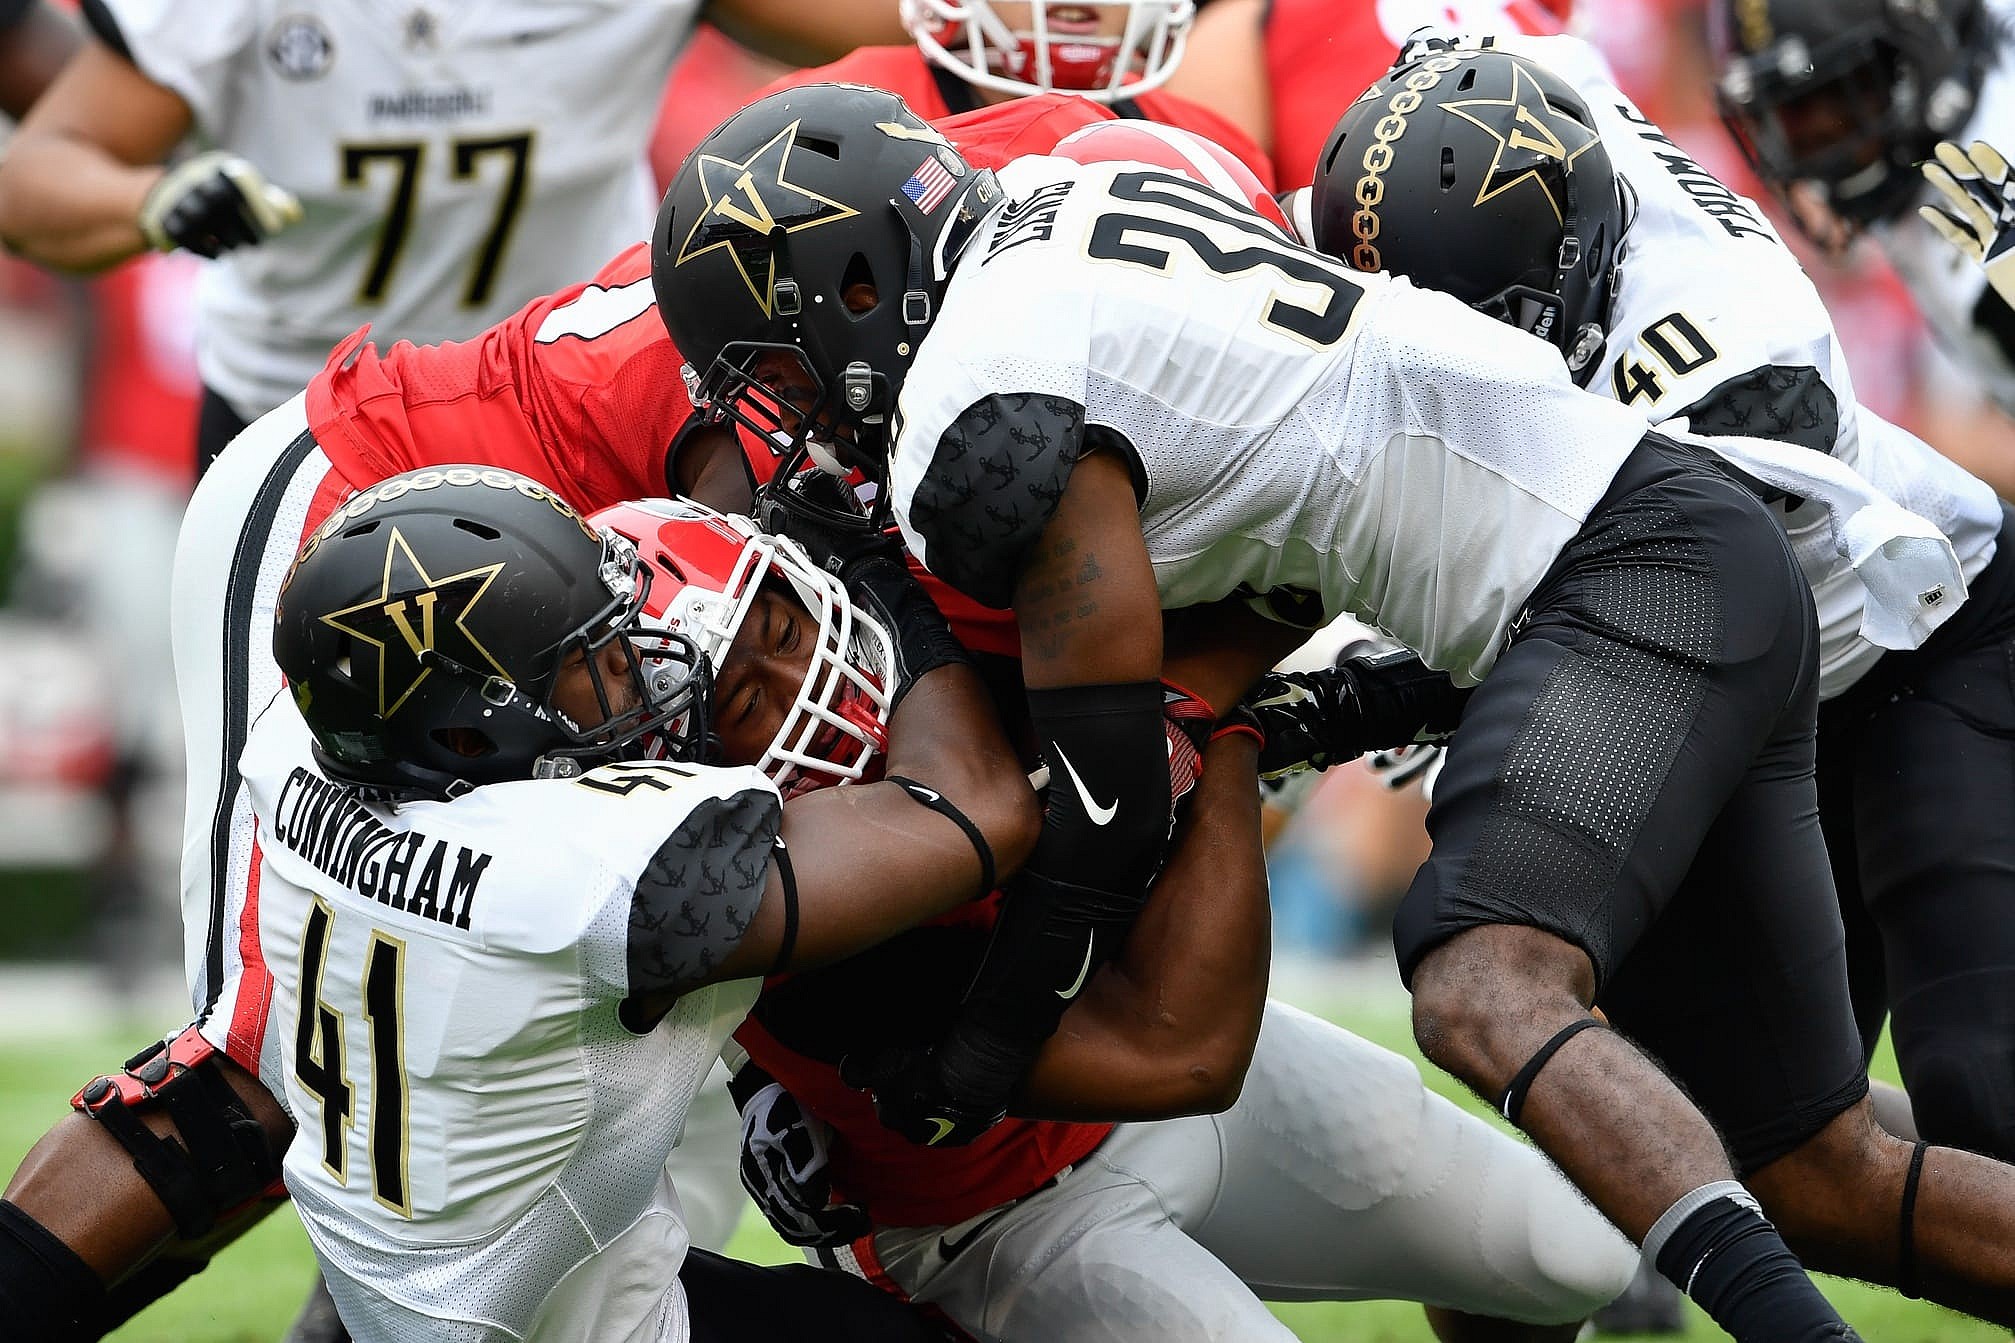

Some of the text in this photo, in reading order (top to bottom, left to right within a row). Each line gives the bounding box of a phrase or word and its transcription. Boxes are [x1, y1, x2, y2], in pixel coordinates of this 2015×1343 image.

[338, 129, 538, 308] 77
[1081, 170, 1366, 353] 30
[1611, 311, 1719, 407] 40
[274, 766, 493, 932] CUNNINGHAM
[572, 764, 699, 799] 41
[294, 894, 413, 1221] 41
